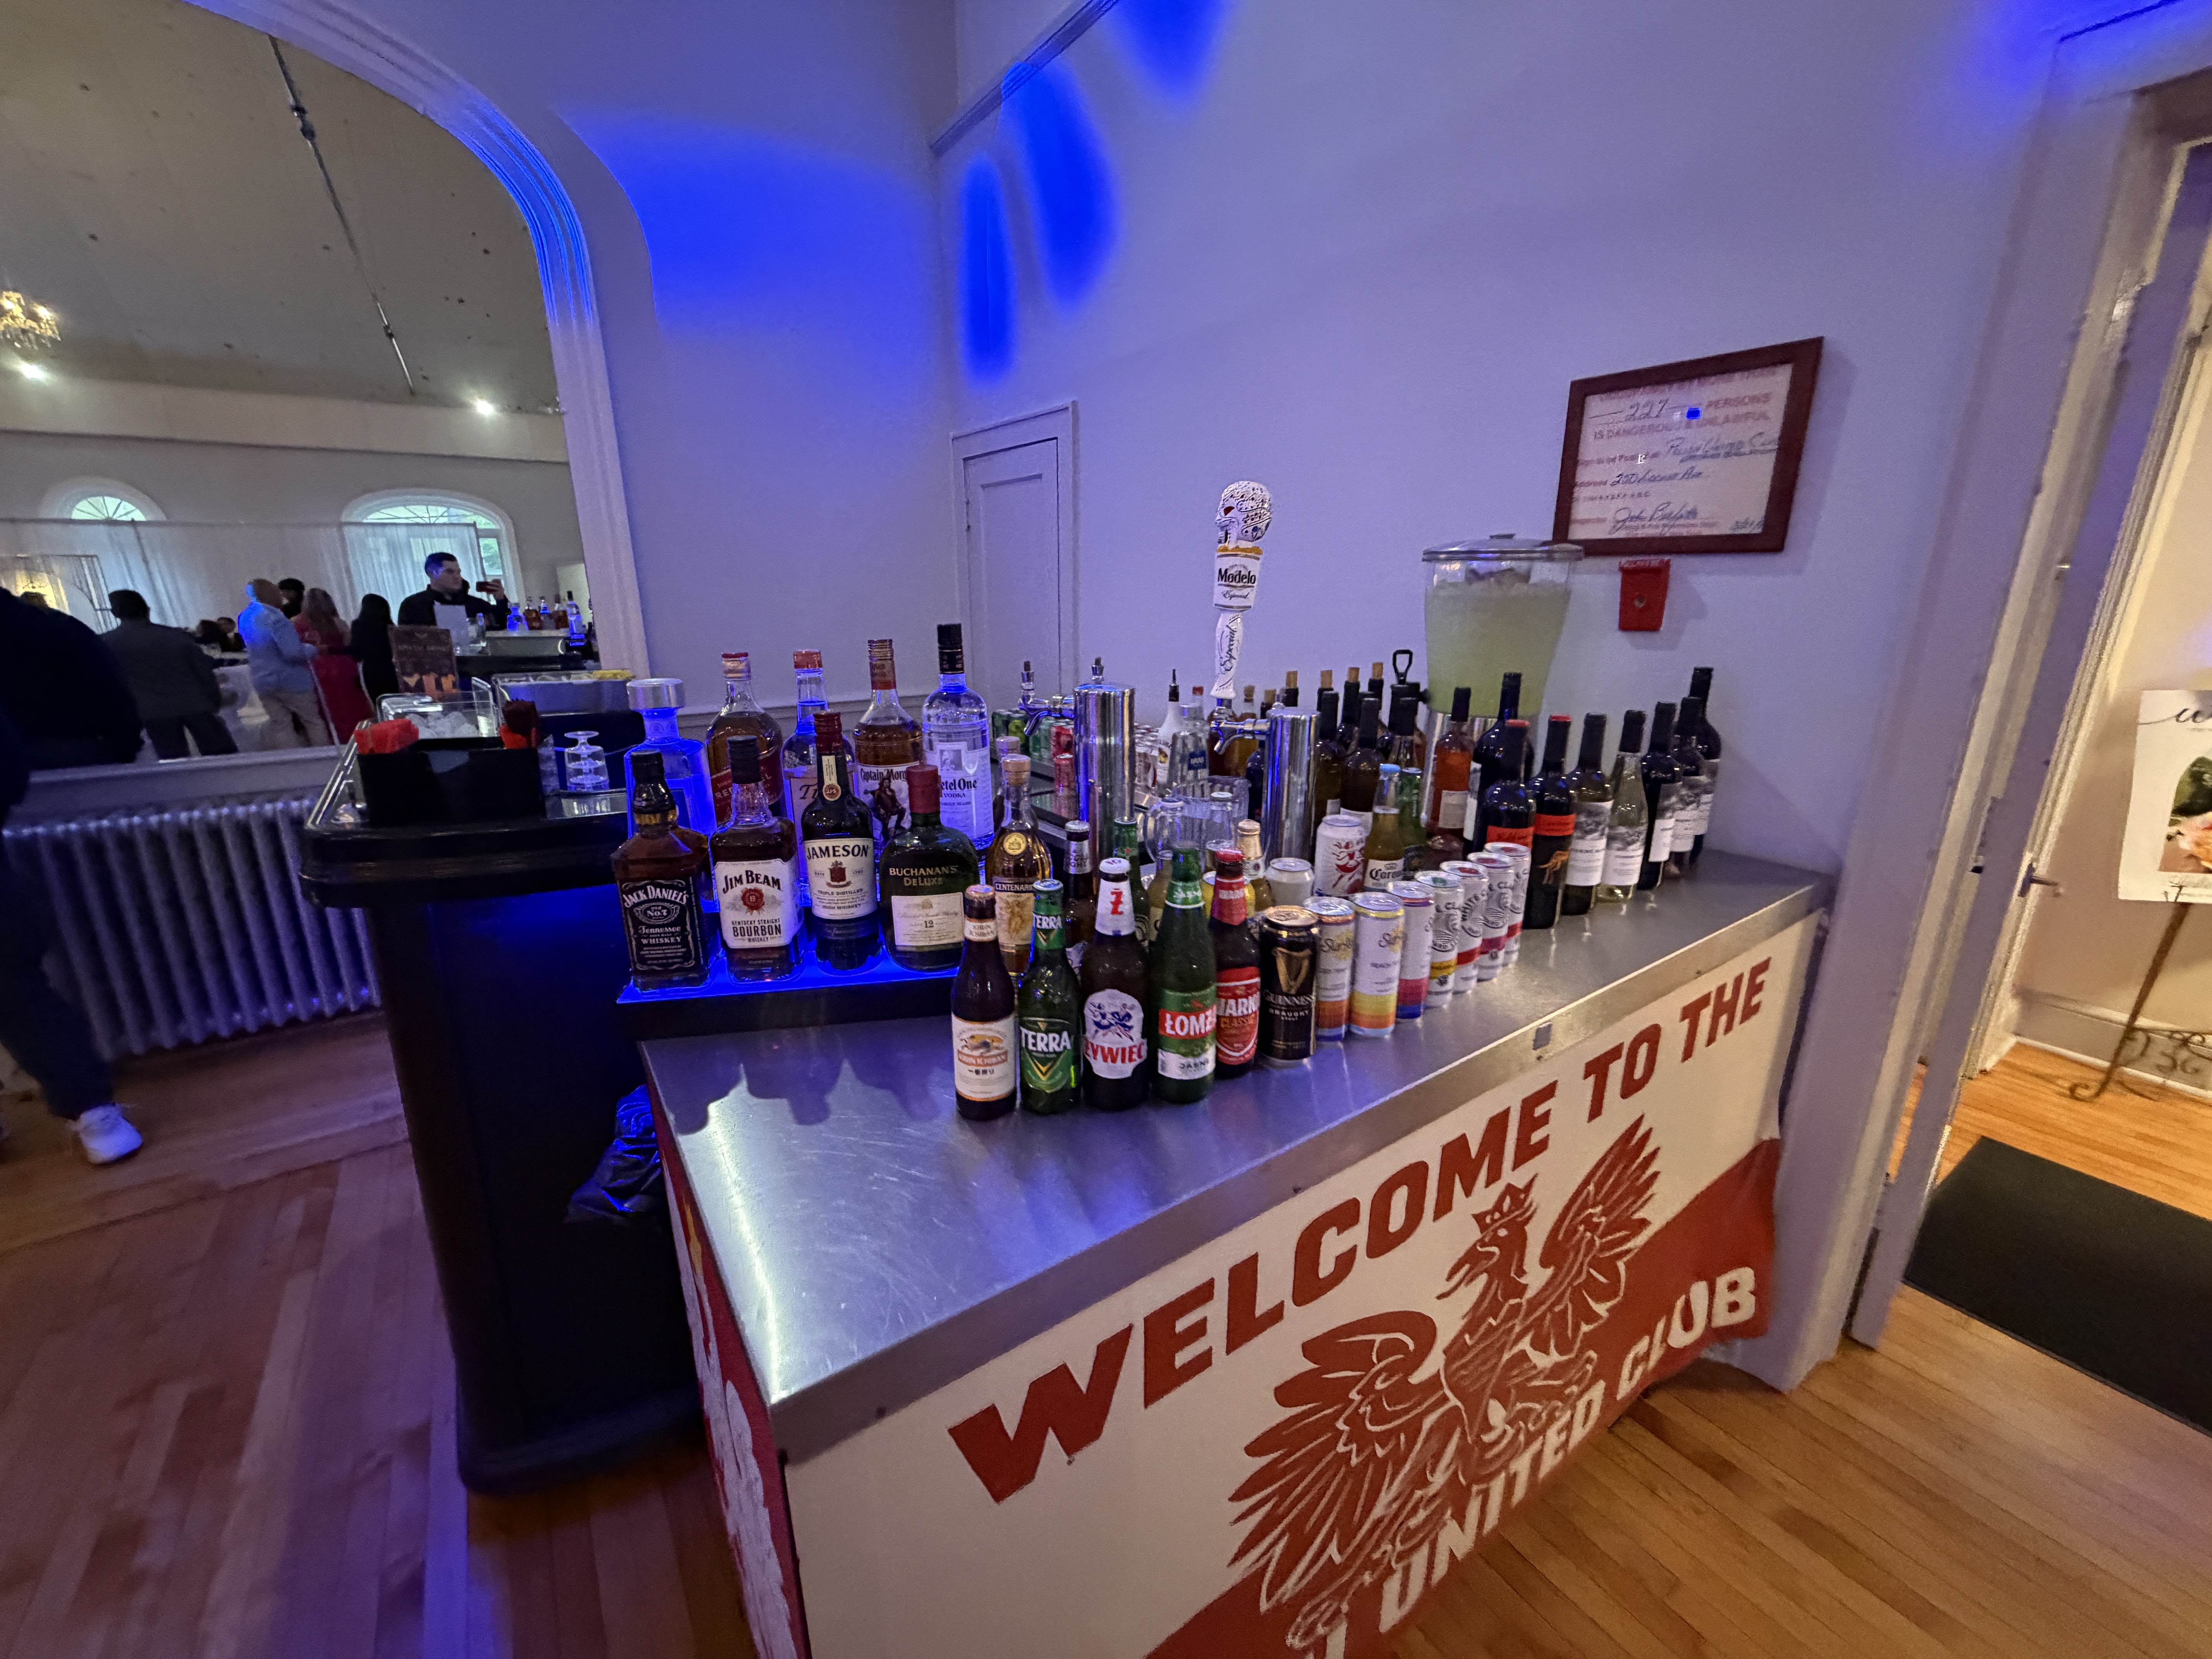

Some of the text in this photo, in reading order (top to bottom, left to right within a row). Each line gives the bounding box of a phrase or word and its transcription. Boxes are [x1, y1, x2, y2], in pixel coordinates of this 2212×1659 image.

[1628, 399, 1669, 421] 227
[1218, 568, 1256, 584] Modelo
[860, 768, 907, 783] Captain Morg
[940, 778, 977, 790] etel One
[715, 787, 732, 799] RE
[807, 844, 869, 860] JAMESON
[723, 870, 782, 894] JIM BEAM
[622, 890, 647, 908] JACK
[639, 926, 681, 934] Tennessee
[733, 924, 782, 937] BOURBON
[924, 920, 934, 928] 12
[641, 936, 682, 945] WHISKEY
[1217, 993, 1260, 1017] ARK
[1164, 1008, 1216, 1036] ŁOMŻ
[1020, 1025, 1072, 1053] TERRA
[947, 957, 1772, 1505] WELCOME TO THE
